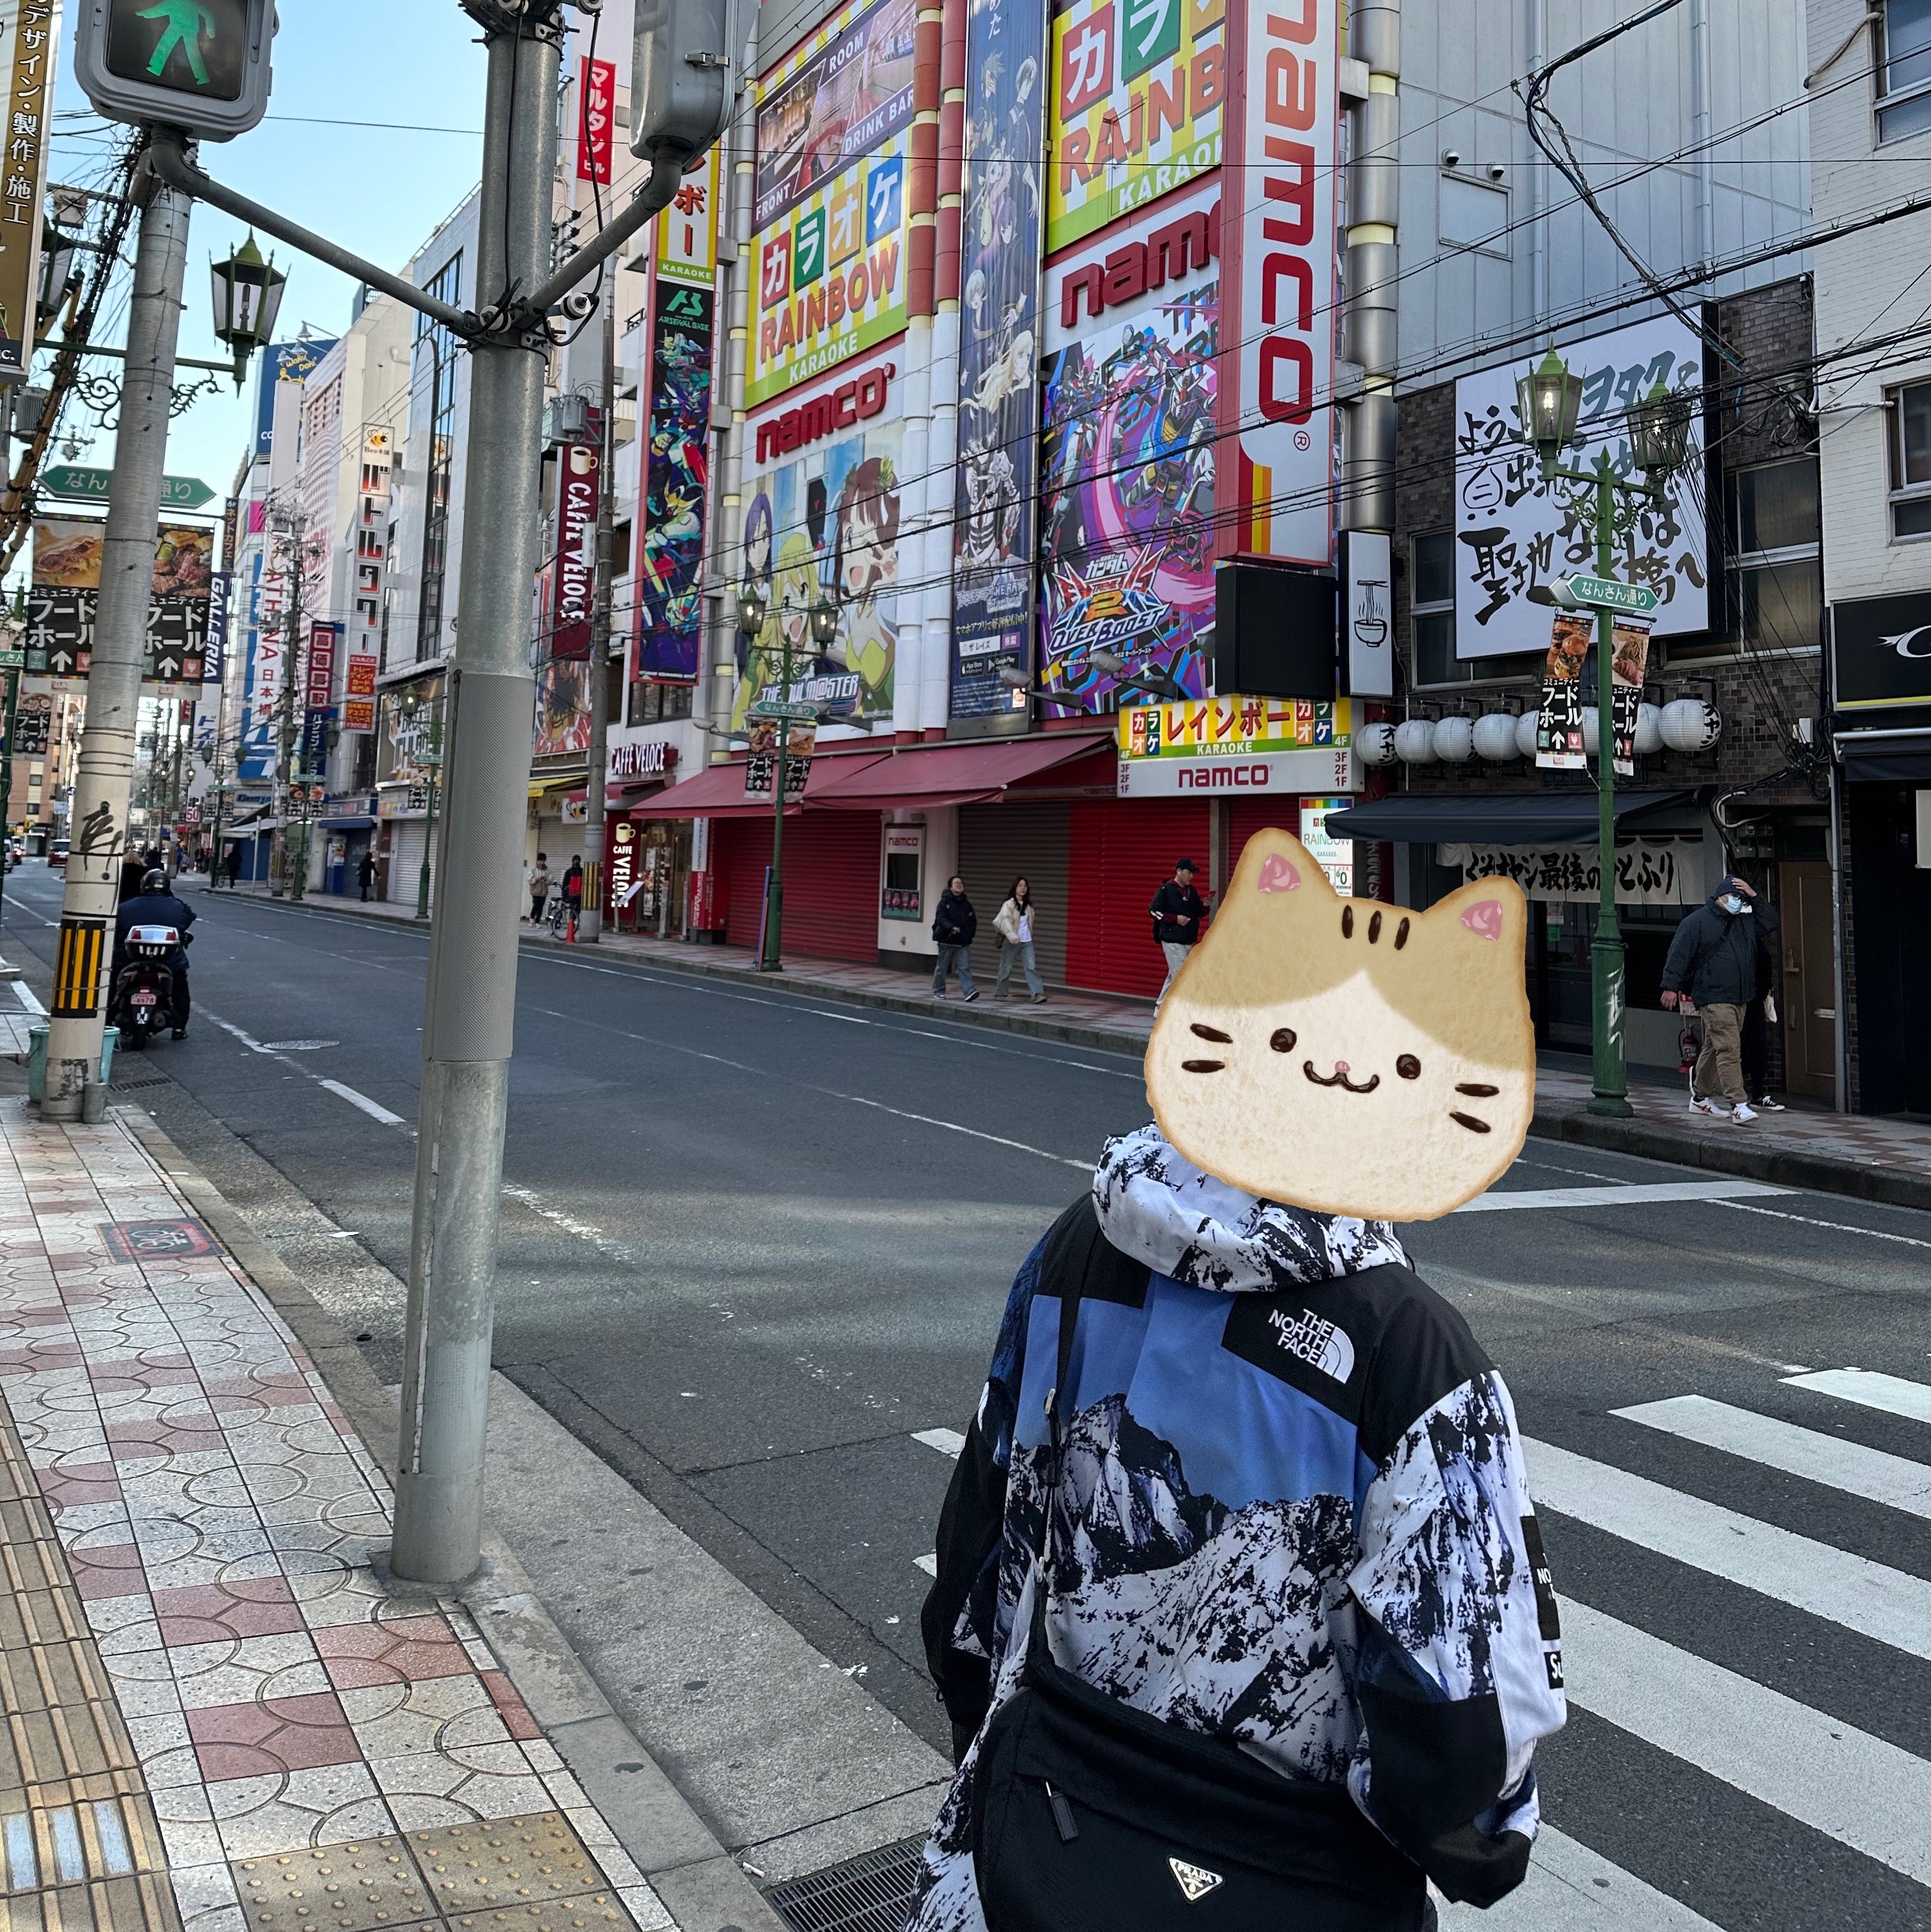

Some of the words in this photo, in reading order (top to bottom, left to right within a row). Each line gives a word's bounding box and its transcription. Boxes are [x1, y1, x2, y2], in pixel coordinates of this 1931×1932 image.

[829, 34, 864, 74] ROOM
[3, 0, 50, 225] デザイン・製作・施工
[586, 66, 609, 155] マルタン
[844, 114, 885, 155] DRINK
[889, 89, 915, 121] BAR
[583, 159, 605, 174] ビル
[755, 183, 791, 222] FRONT
[765, 166, 898, 298] カラオケ
[662, 263, 712, 279] KARAOKE
[760, 241, 900, 364] RAINBOW
[790, 332, 858, 384] KARAOKE
[756, 365, 889, 464] namco
[1086, 553, 1129, 579] ガンダム
[30, 587, 98, 598] コミュニティー
[1582, 581, 1648, 606] なんさん通り
[29, 598, 97, 622] フード
[147, 606, 205, 631] フード
[261, 568, 284, 661] ATHNA
[204, 576, 224, 678] GALLERIA
[259, 668, 275, 716] 日本橋
[1542, 686, 1579, 707] フード
[765, 703, 811, 716] なんさん通り
[1167, 700, 1290, 742] レインボー
[1539, 707, 1582, 728] ホール
[19, 716, 49, 728] フード
[1702, 703, 1721, 749] オヤジ
[16, 728, 49, 740] ホール
[1334, 736, 1347, 747] 4F
[636, 742, 666, 772] VELOCE
[1120, 750, 1131, 759] 4F
[1196, 741, 1253, 756] KARAOKE
[1334, 752, 1348, 762] 3F
[747, 768, 774, 779] ホール
[749, 758, 773, 769] フード
[787, 759, 811, 771] フード
[1120, 763, 1130, 772] 3F
[1334, 764, 1348, 774] 2F
[785, 770, 809, 781] ホール
[1120, 774, 1130, 783] 2F
[1179, 764, 1269, 788] namco
[1334, 776, 1348, 786] 1F
[1120, 785, 1130, 794] 1F
[888, 836, 919, 847] namco
[1268, 1308, 1329, 1353] NORTH
[1302, 1308, 1335, 1338] THE
[1277, 1331, 1322, 1365] FACE
[1177, 1862, 1213, 1884] PRADA
